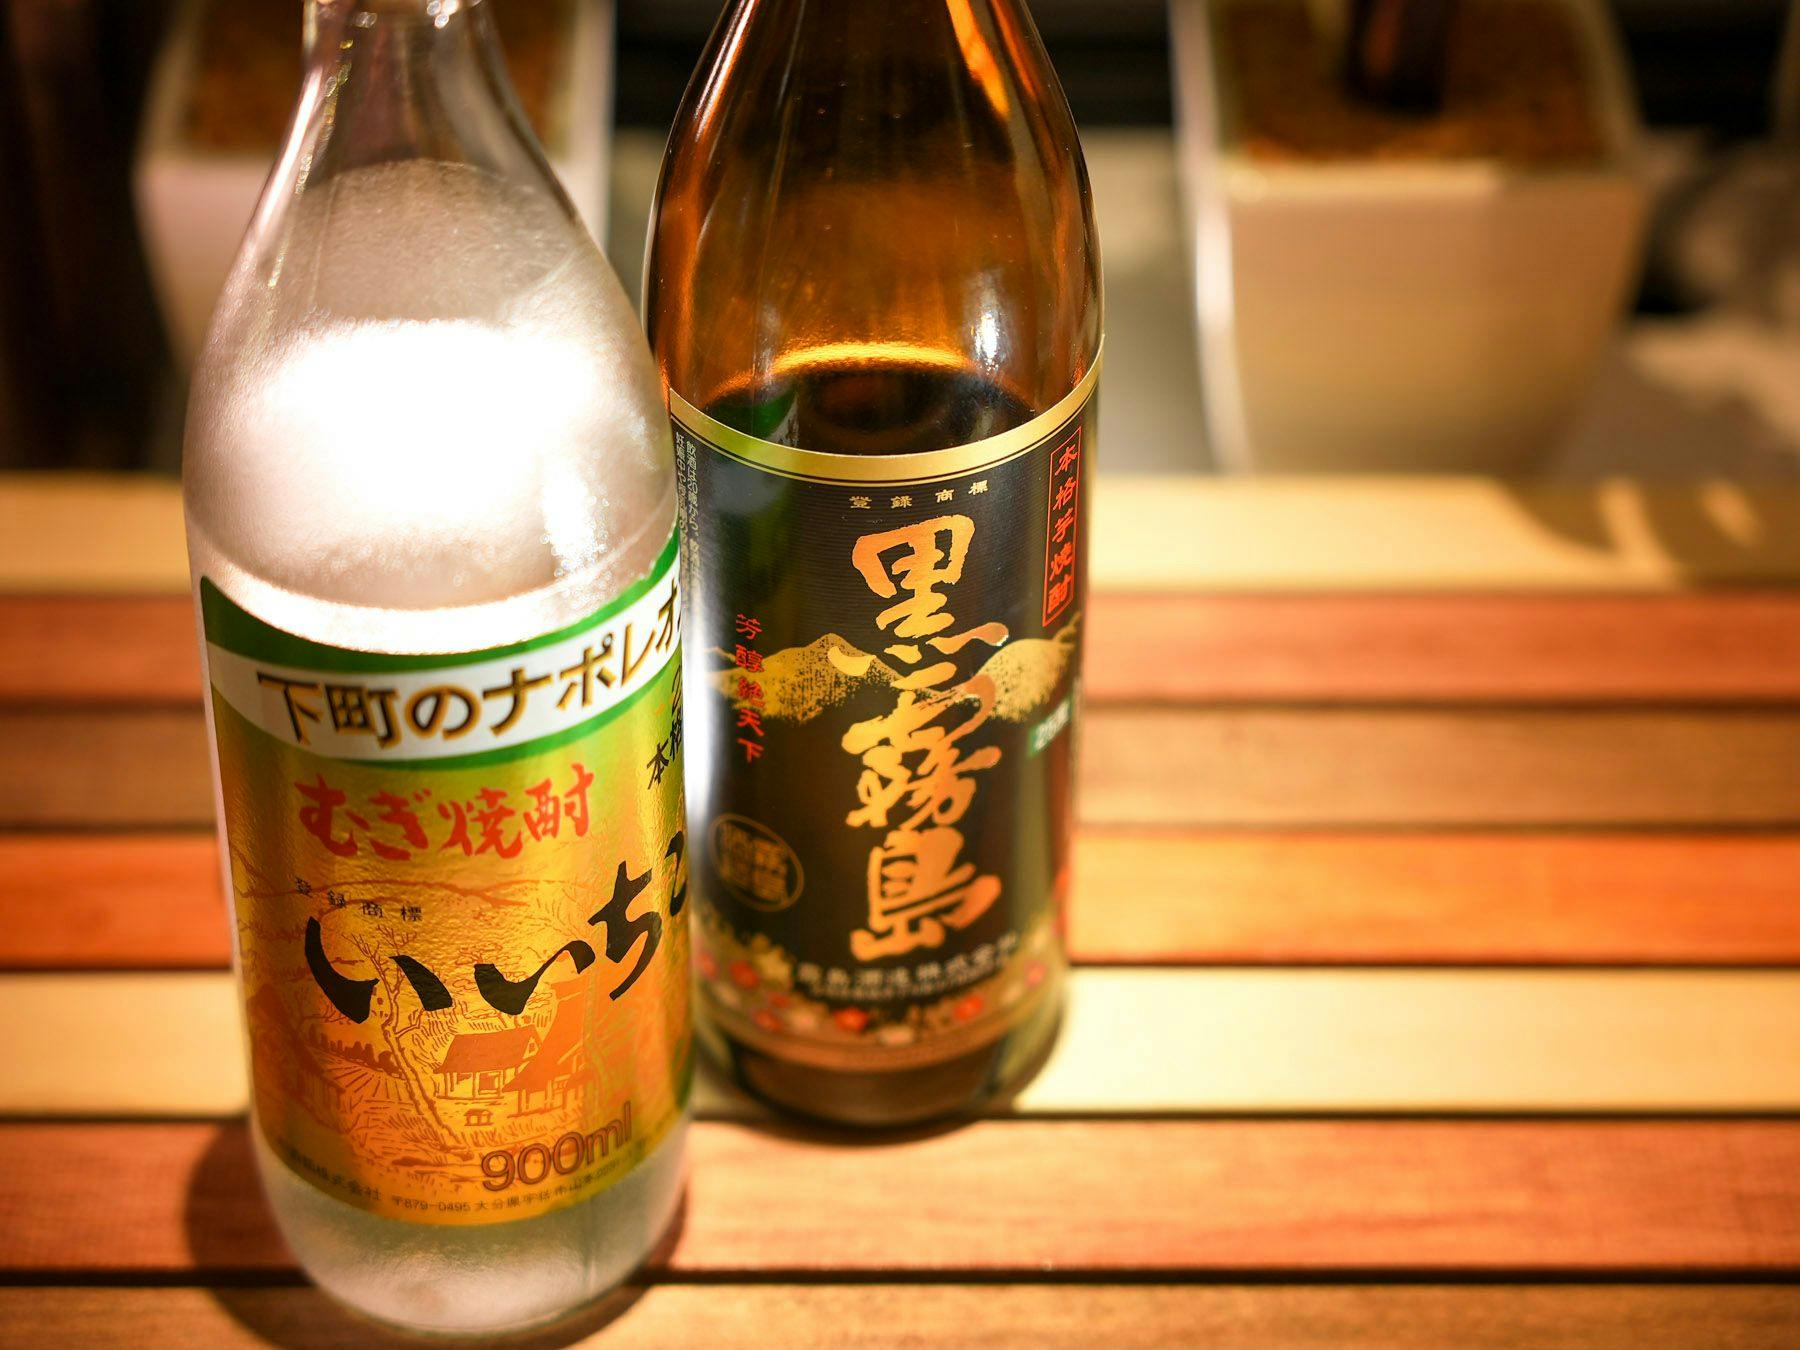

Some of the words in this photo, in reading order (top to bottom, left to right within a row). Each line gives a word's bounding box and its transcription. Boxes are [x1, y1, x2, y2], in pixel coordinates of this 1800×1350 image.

[849, 479, 989, 510] 登録商標
[1048, 444, 1077, 614] 本格芋焼酎
[257, 577, 681, 749] 下町のナポレオ
[828, 514, 1010, 962] 黒霧島
[295, 763, 595, 861] むぎ焼酎
[480, 1101, 633, 1192] 900ml
